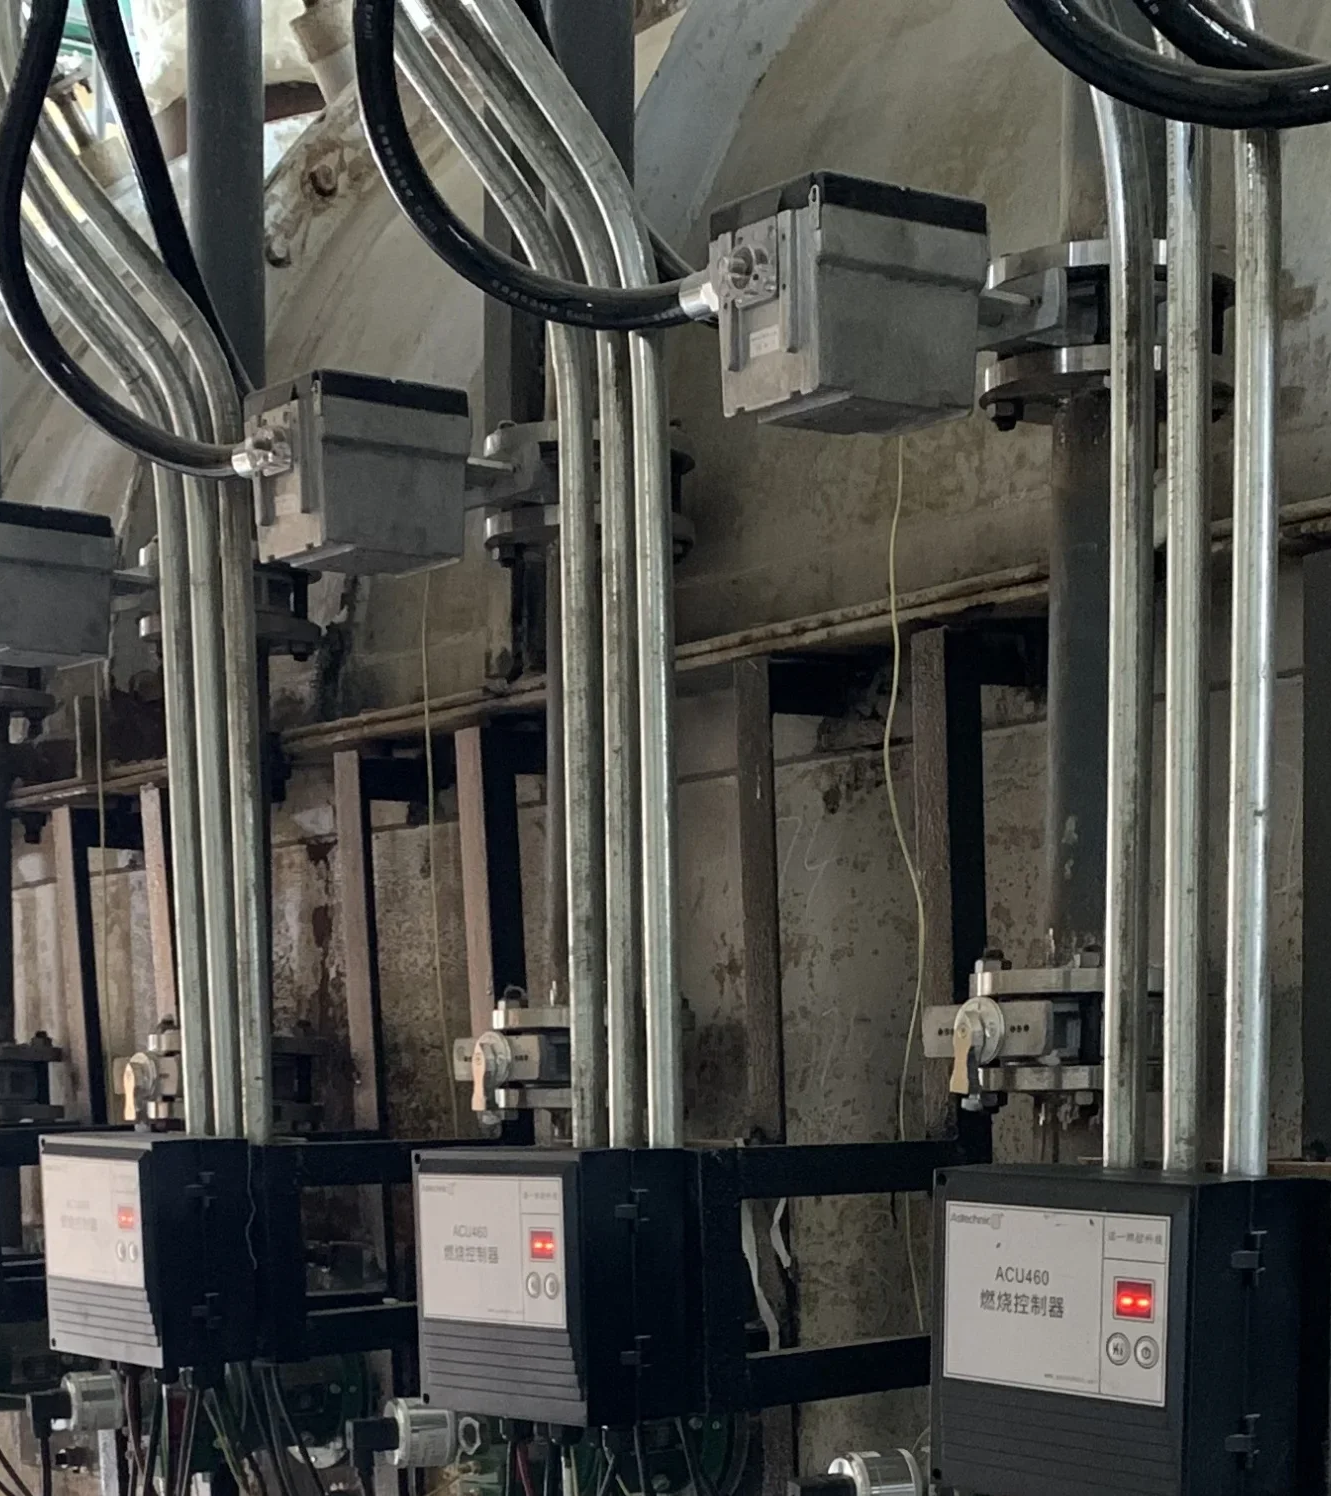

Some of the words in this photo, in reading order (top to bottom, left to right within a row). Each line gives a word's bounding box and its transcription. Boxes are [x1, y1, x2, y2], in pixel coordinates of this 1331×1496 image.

[994, 1265, 1050, 1287] ACU460
[979, 1288, 1065, 1319] 燃烧控制器
